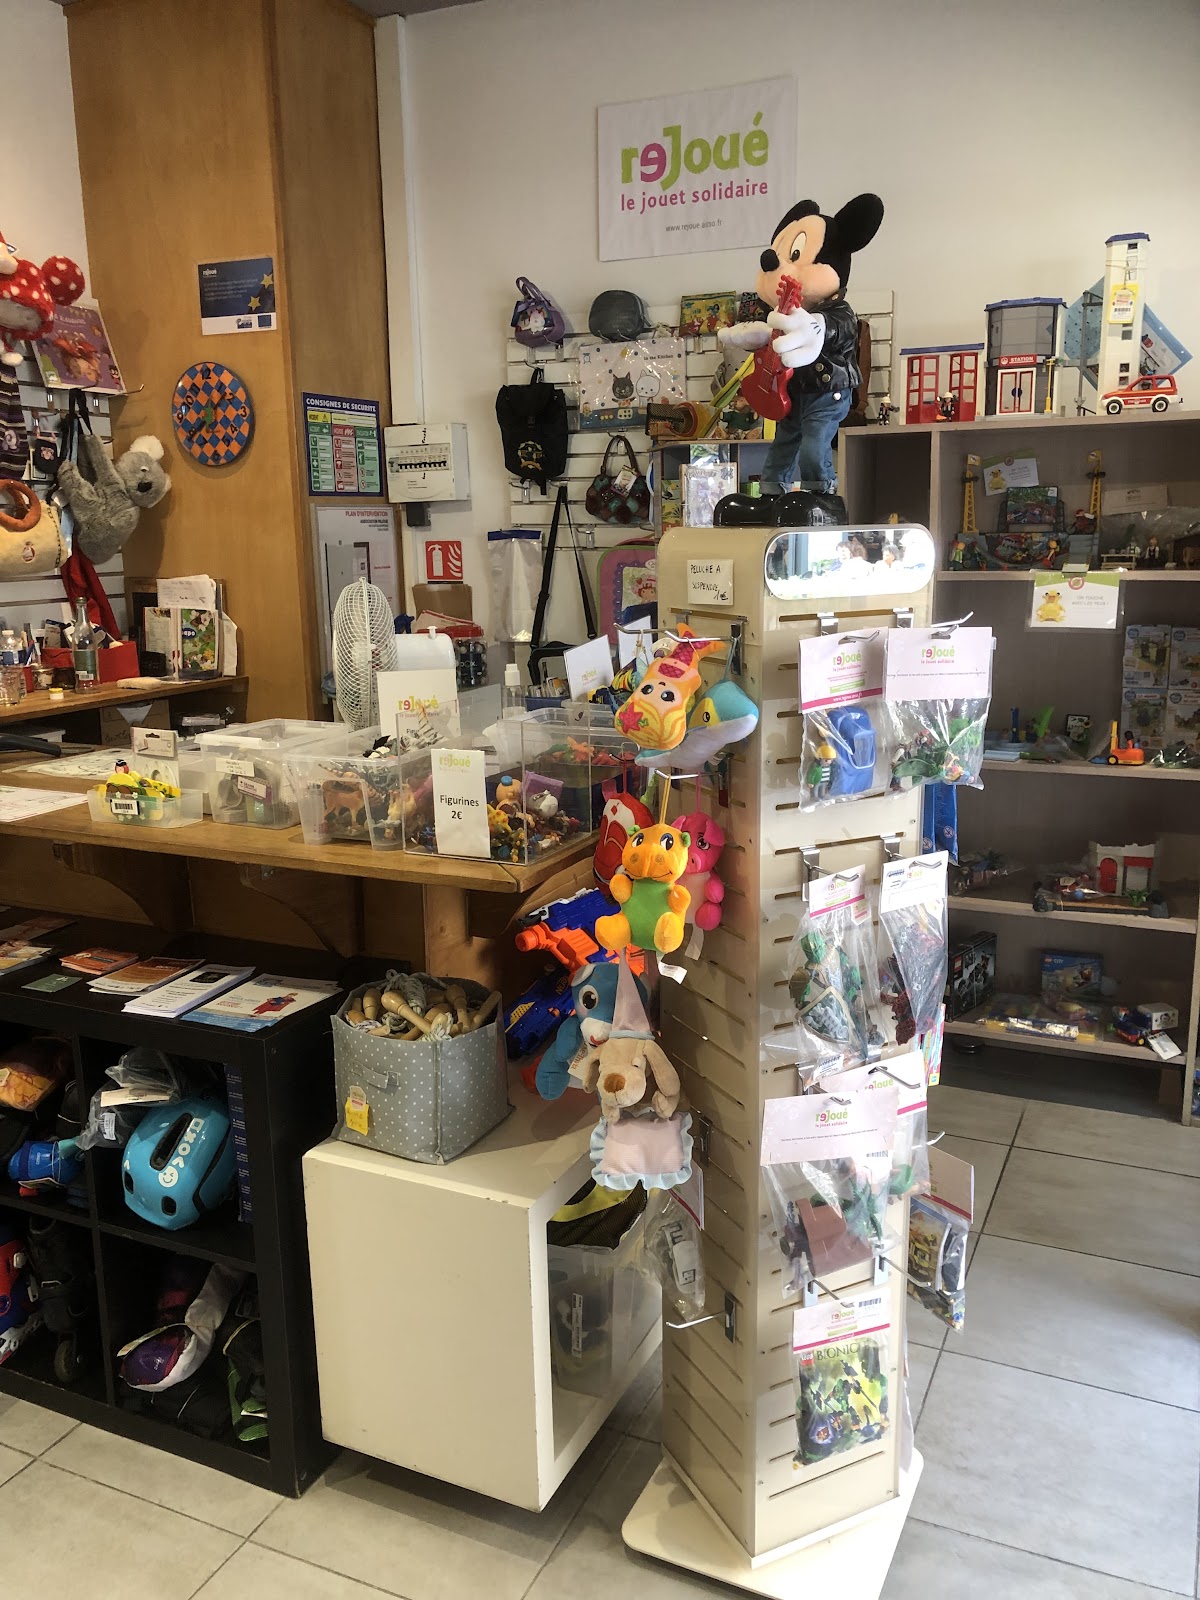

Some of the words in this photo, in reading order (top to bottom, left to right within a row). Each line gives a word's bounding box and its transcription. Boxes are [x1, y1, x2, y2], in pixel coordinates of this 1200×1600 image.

[621, 194, 635, 212] le
[640, 190, 685, 214] jouet
[691, 180, 768, 204] solidaire
[306, 398, 341, 408] CONSIGNES
[342, 402, 350, 410] DE
[240, 406, 247, 418] 3
[229, 423, 238, 434] 4
[440, 795, 480, 807] Figurines
[451, 810, 463, 820] 2€
[816, 1341, 861, 1361] BIONIC
